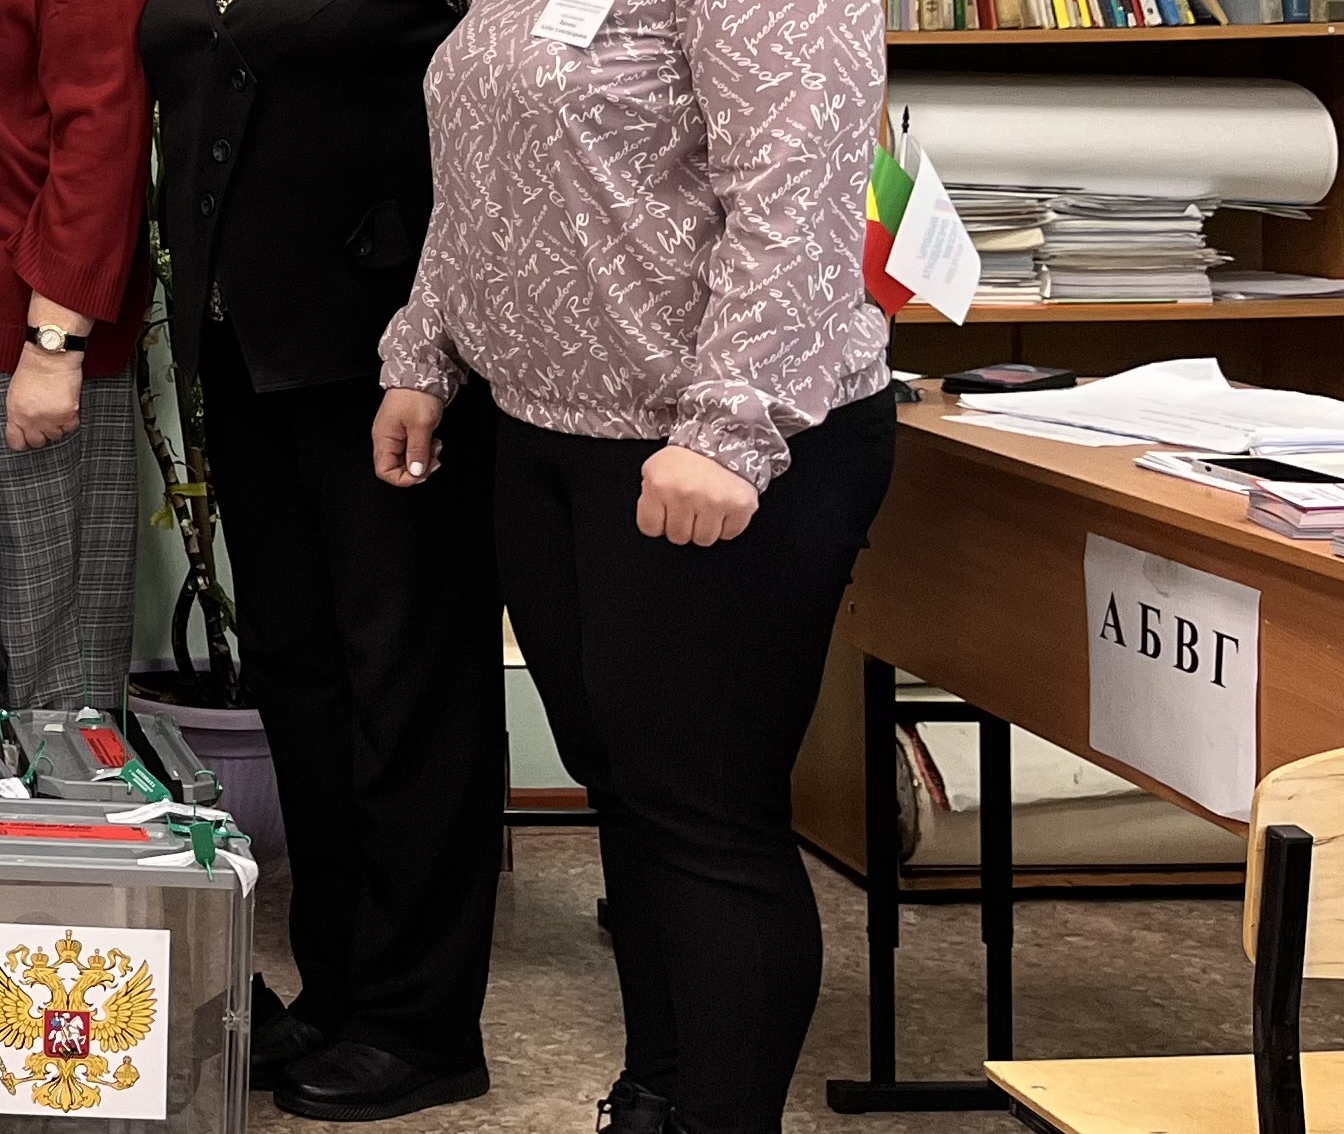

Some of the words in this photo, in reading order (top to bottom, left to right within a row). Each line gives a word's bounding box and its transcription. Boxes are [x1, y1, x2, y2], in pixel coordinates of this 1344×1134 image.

[721, 3, 761, 37] Sun
[744, 2, 795, 56] freedom
[536, 55, 582, 91] life
[715, 39, 794, 92] forever
[578, 71, 648, 102] adventure
[558, 103, 606, 128] Trip
[745, 90, 797, 147] adventure
[809, 90, 846, 132] life
[530, 118, 564, 162] Road
[580, 129, 618, 151] Sun
[598, 137, 651, 176] freedom
[628, 126, 681, 174] Road
[771, 129, 818, 162] Love
[734, 143, 772, 180] Trip
[757, 168, 812, 215] freedom
[791, 163, 834, 211] Road
[656, 215, 698, 255] life
[534, 240, 578, 276] Love
[587, 254, 626, 284] Trip
[739, 254, 802, 300] adventure
[528, 276, 551, 304] Sun
[609, 279, 642, 304] Sun
[807, 261, 841, 302] life
[656, 280, 703, 325] Road
[719, 300, 767, 329] Trip
[731, 328, 777, 352] Sun
[748, 337, 801, 379] freedom
[778, 330, 825, 378] Road
[696, 387, 750, 414] Trip
